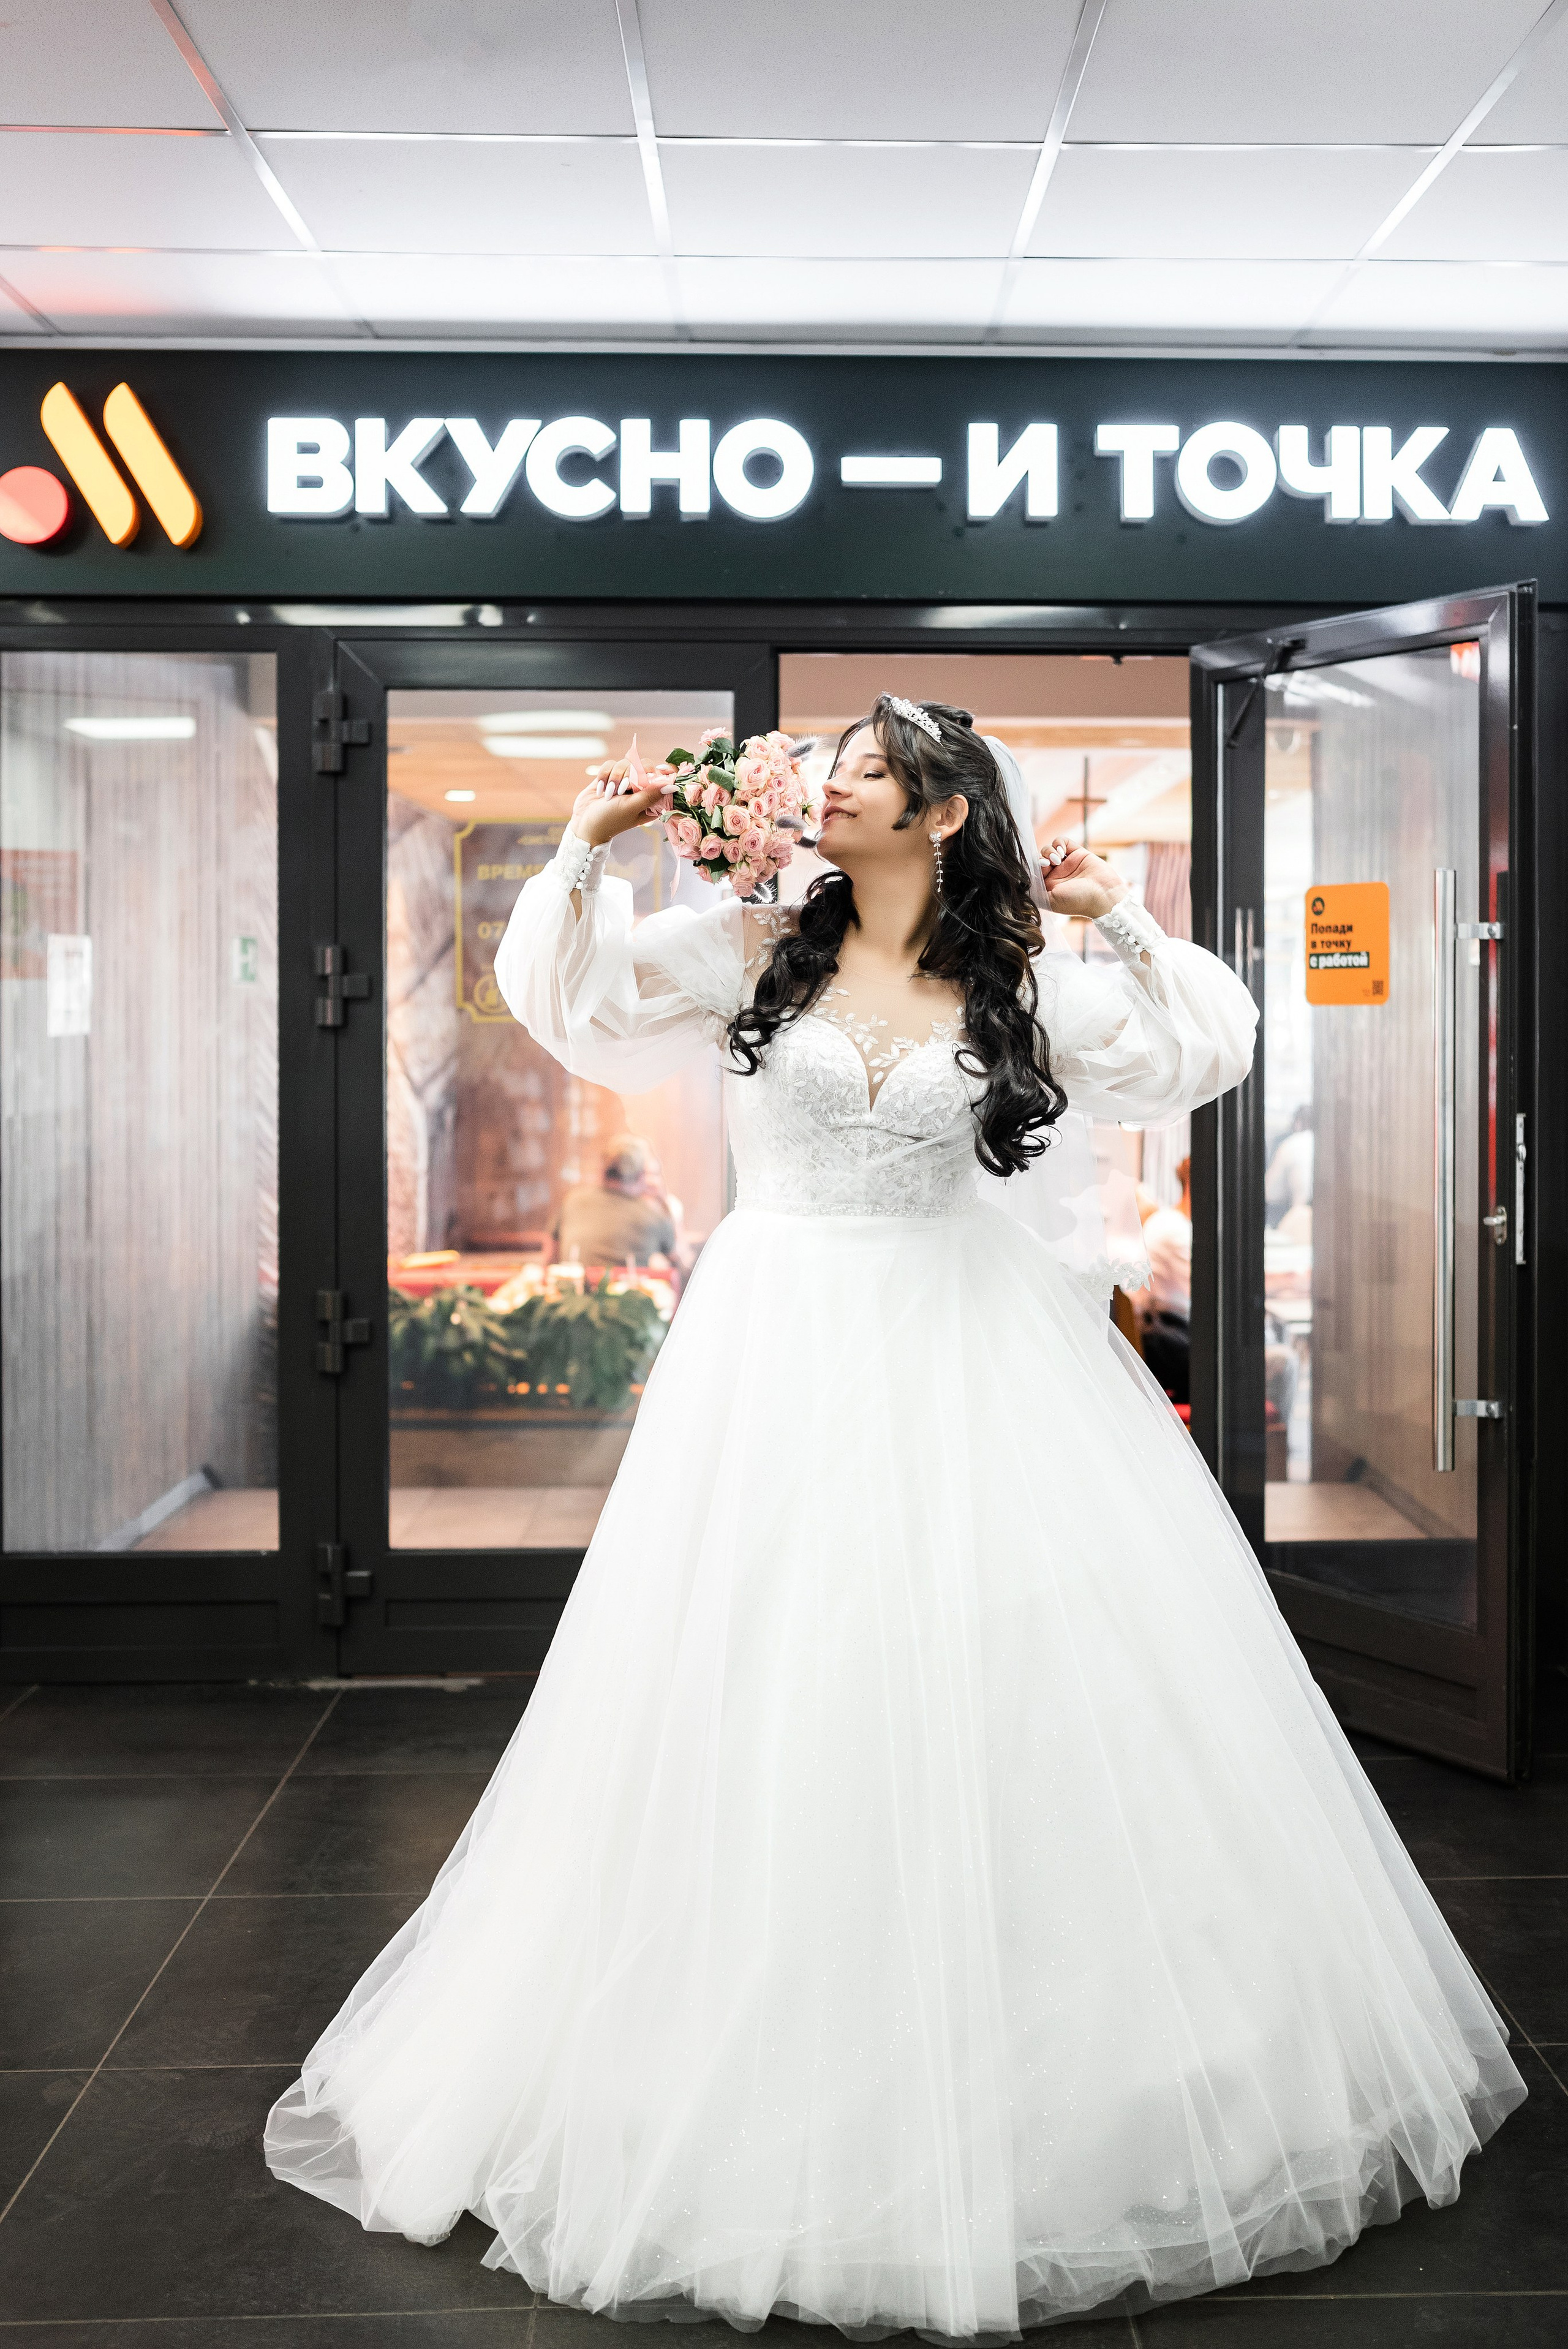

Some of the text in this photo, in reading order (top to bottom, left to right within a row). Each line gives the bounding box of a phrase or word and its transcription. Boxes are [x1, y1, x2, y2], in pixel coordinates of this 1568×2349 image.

[266, 417, 815, 518] ВКУСНО
[967, 422, 1058, 521] И
[1095, 420, 1550, 524] ТОЧКА
[1311, 923, 1353, 935] Попади
[1321, 940, 1351, 951] точку
[1310, 952, 1368, 969] с работой
